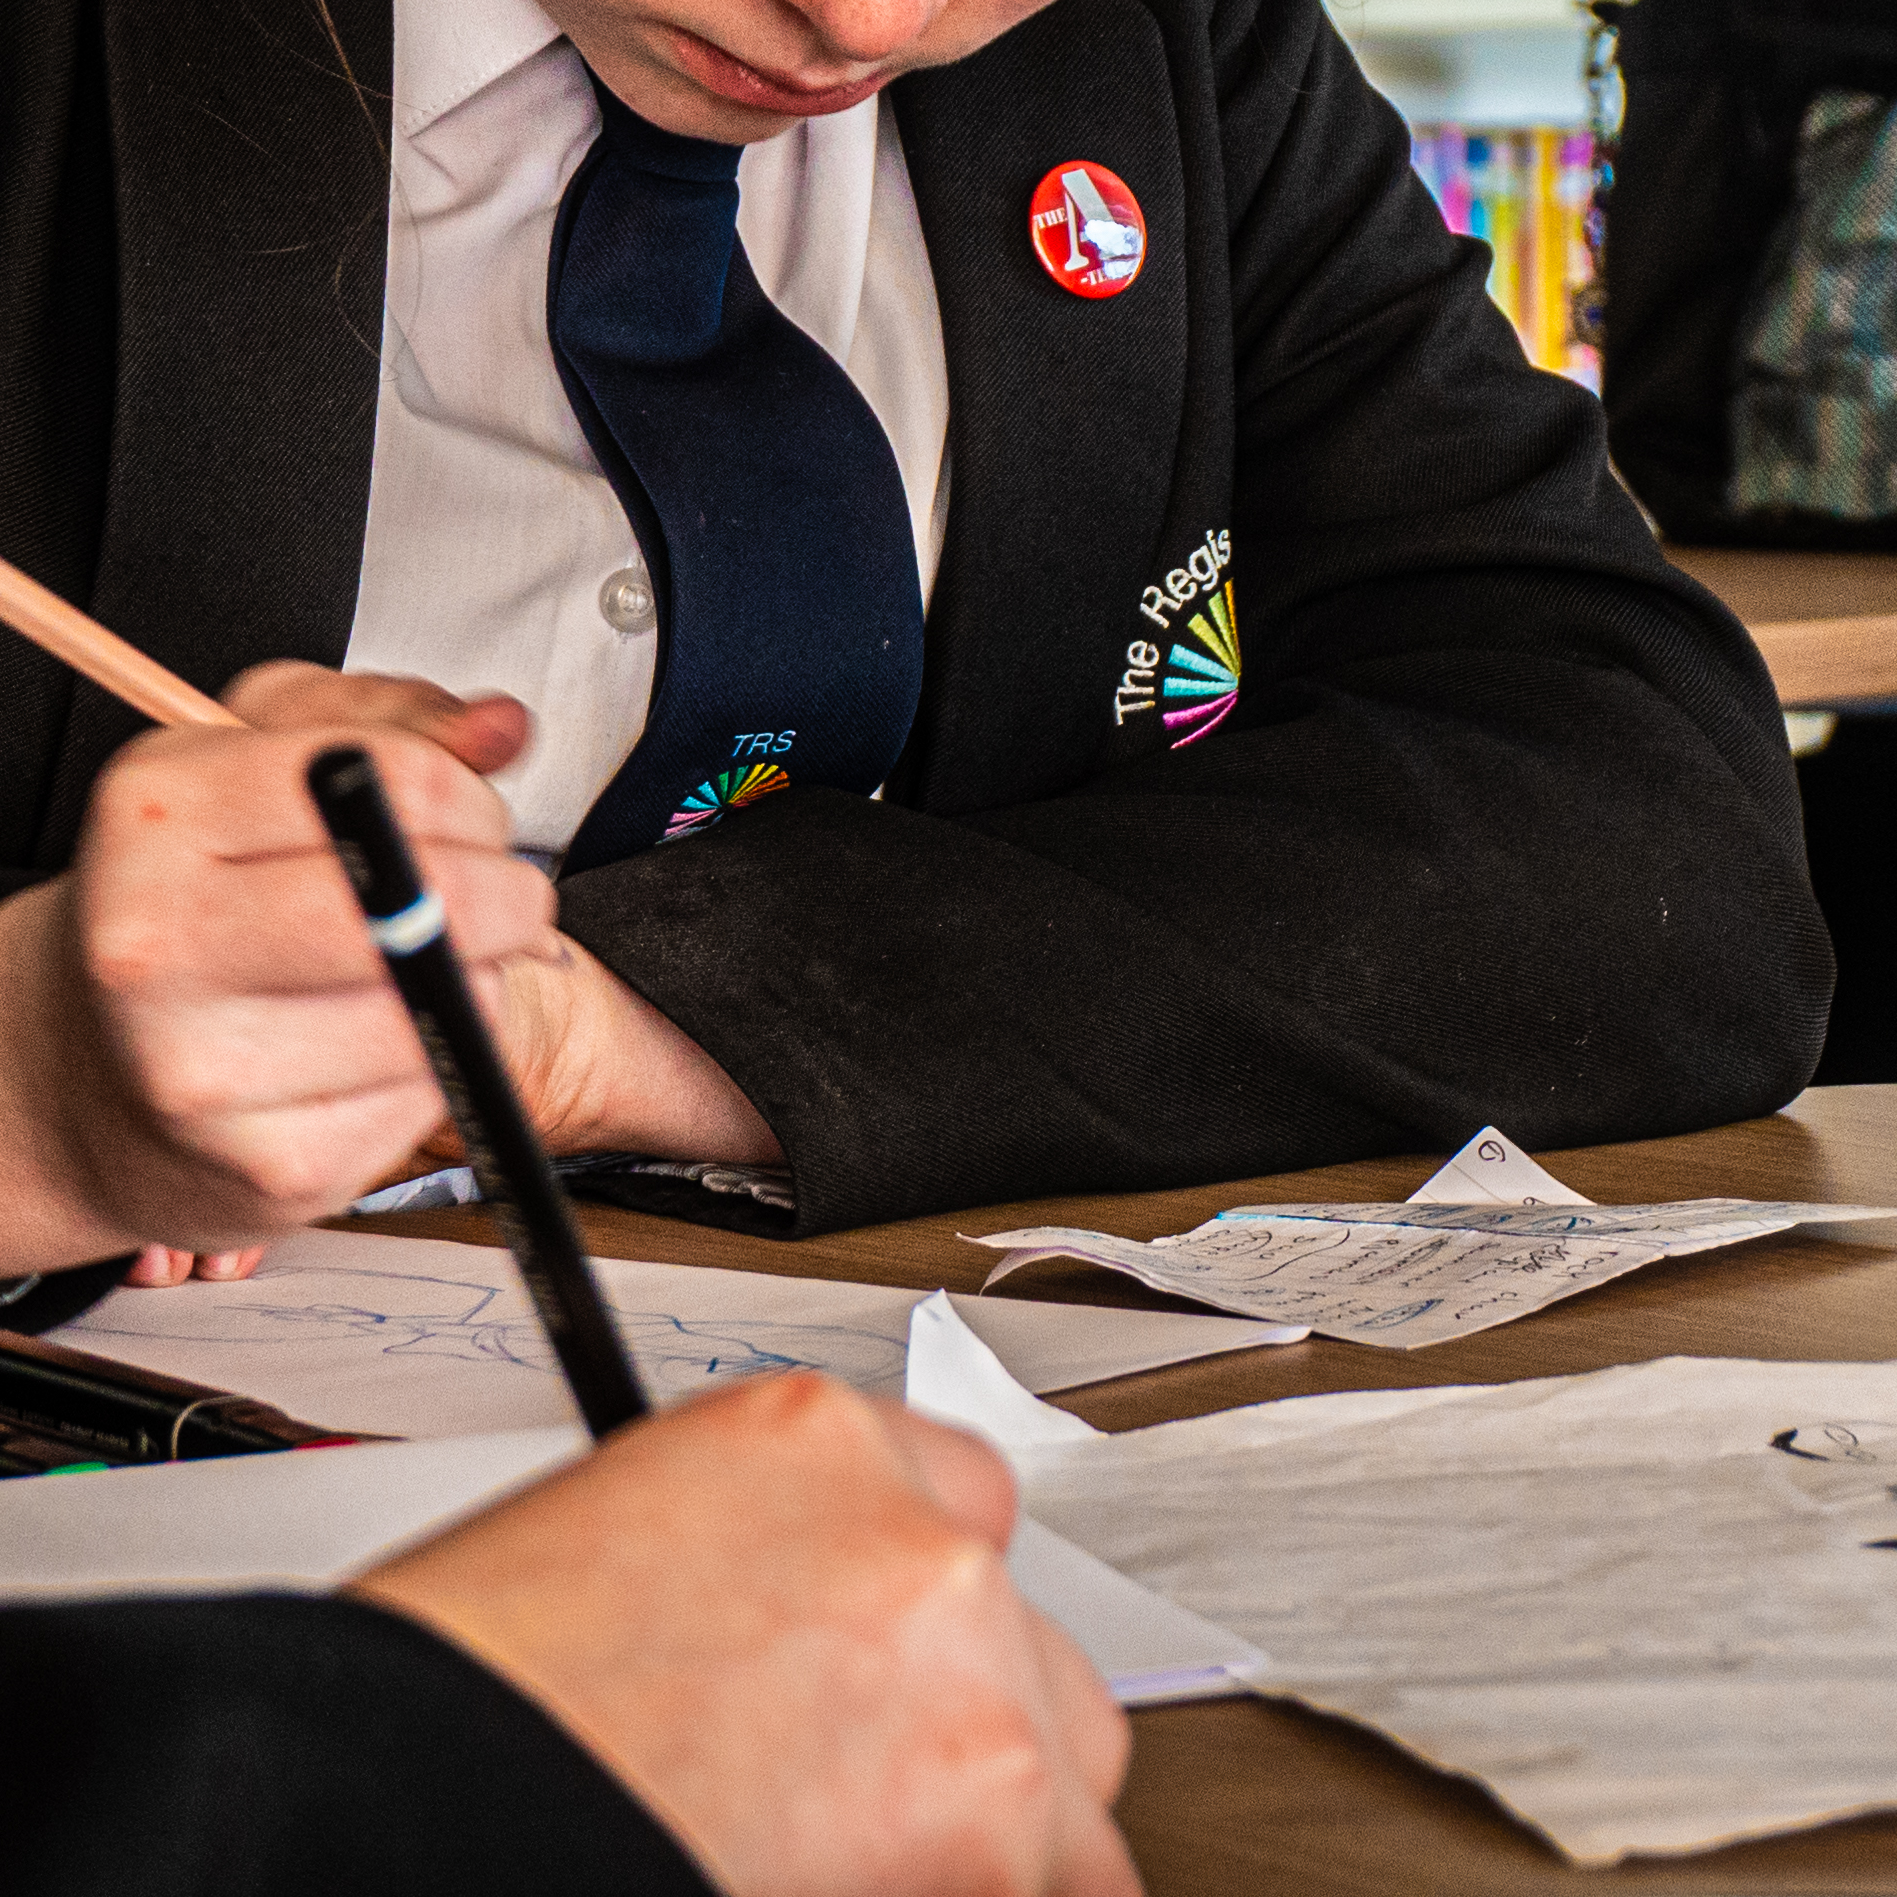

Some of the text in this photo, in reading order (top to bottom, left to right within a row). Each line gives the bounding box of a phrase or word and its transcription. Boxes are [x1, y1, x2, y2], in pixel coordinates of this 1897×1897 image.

[1033, 207, 1067, 229] THE
[1115, 529, 1232, 726] The Regis
[731, 730, 797, 757] TRS
